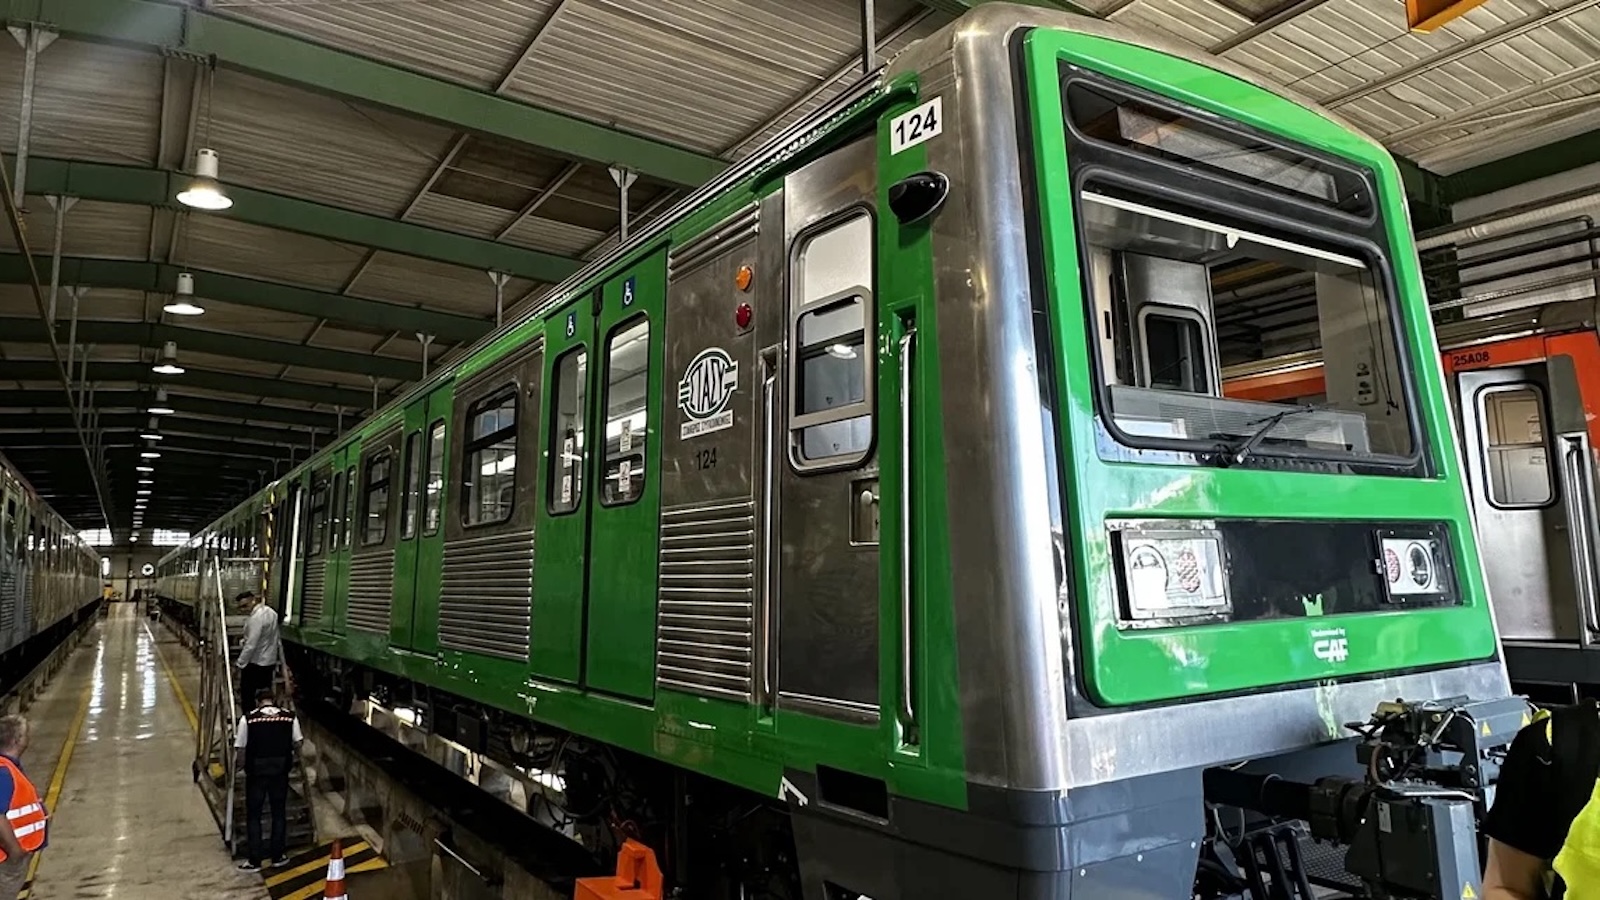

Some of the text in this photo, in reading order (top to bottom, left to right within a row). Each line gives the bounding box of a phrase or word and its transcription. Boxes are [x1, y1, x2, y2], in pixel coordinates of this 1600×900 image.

[896, 105, 937, 145] 124
[1453, 351, 1490, 366] 25A08
[696, 447, 717, 471] 124
[1313, 638, 1349, 662] CAF
